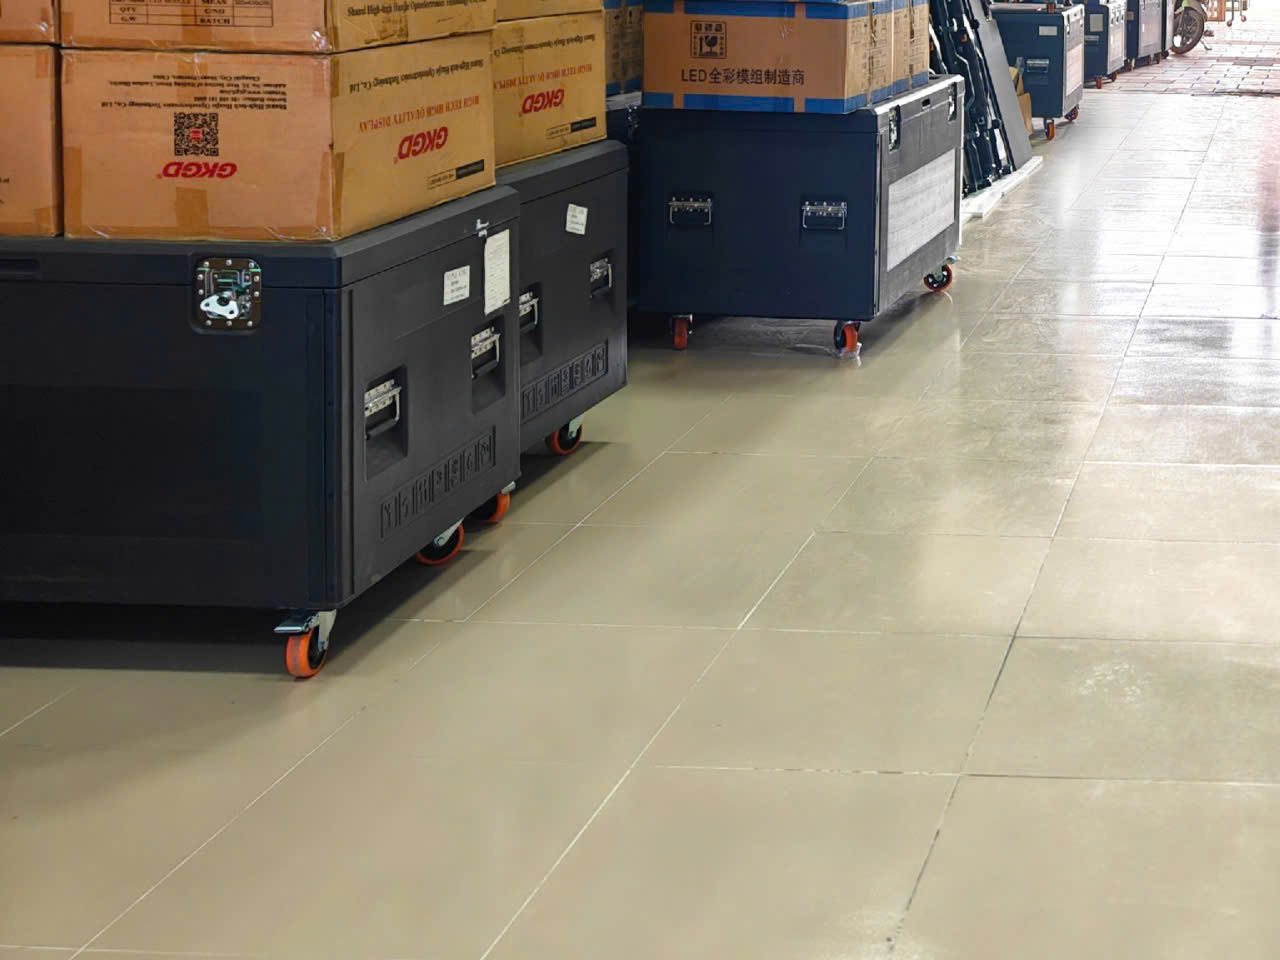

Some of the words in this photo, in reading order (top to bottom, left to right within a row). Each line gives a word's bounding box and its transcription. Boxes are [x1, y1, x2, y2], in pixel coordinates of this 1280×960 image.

[680, 68, 805, 86] LED全彩模组制造商
[522, 88, 564, 114] GKGD
[392, 107, 424, 124] QUALITY
[359, 116, 391, 133] DISPLAY
[398, 126, 448, 160] GKGD
[162, 162, 238, 178] GKGD
